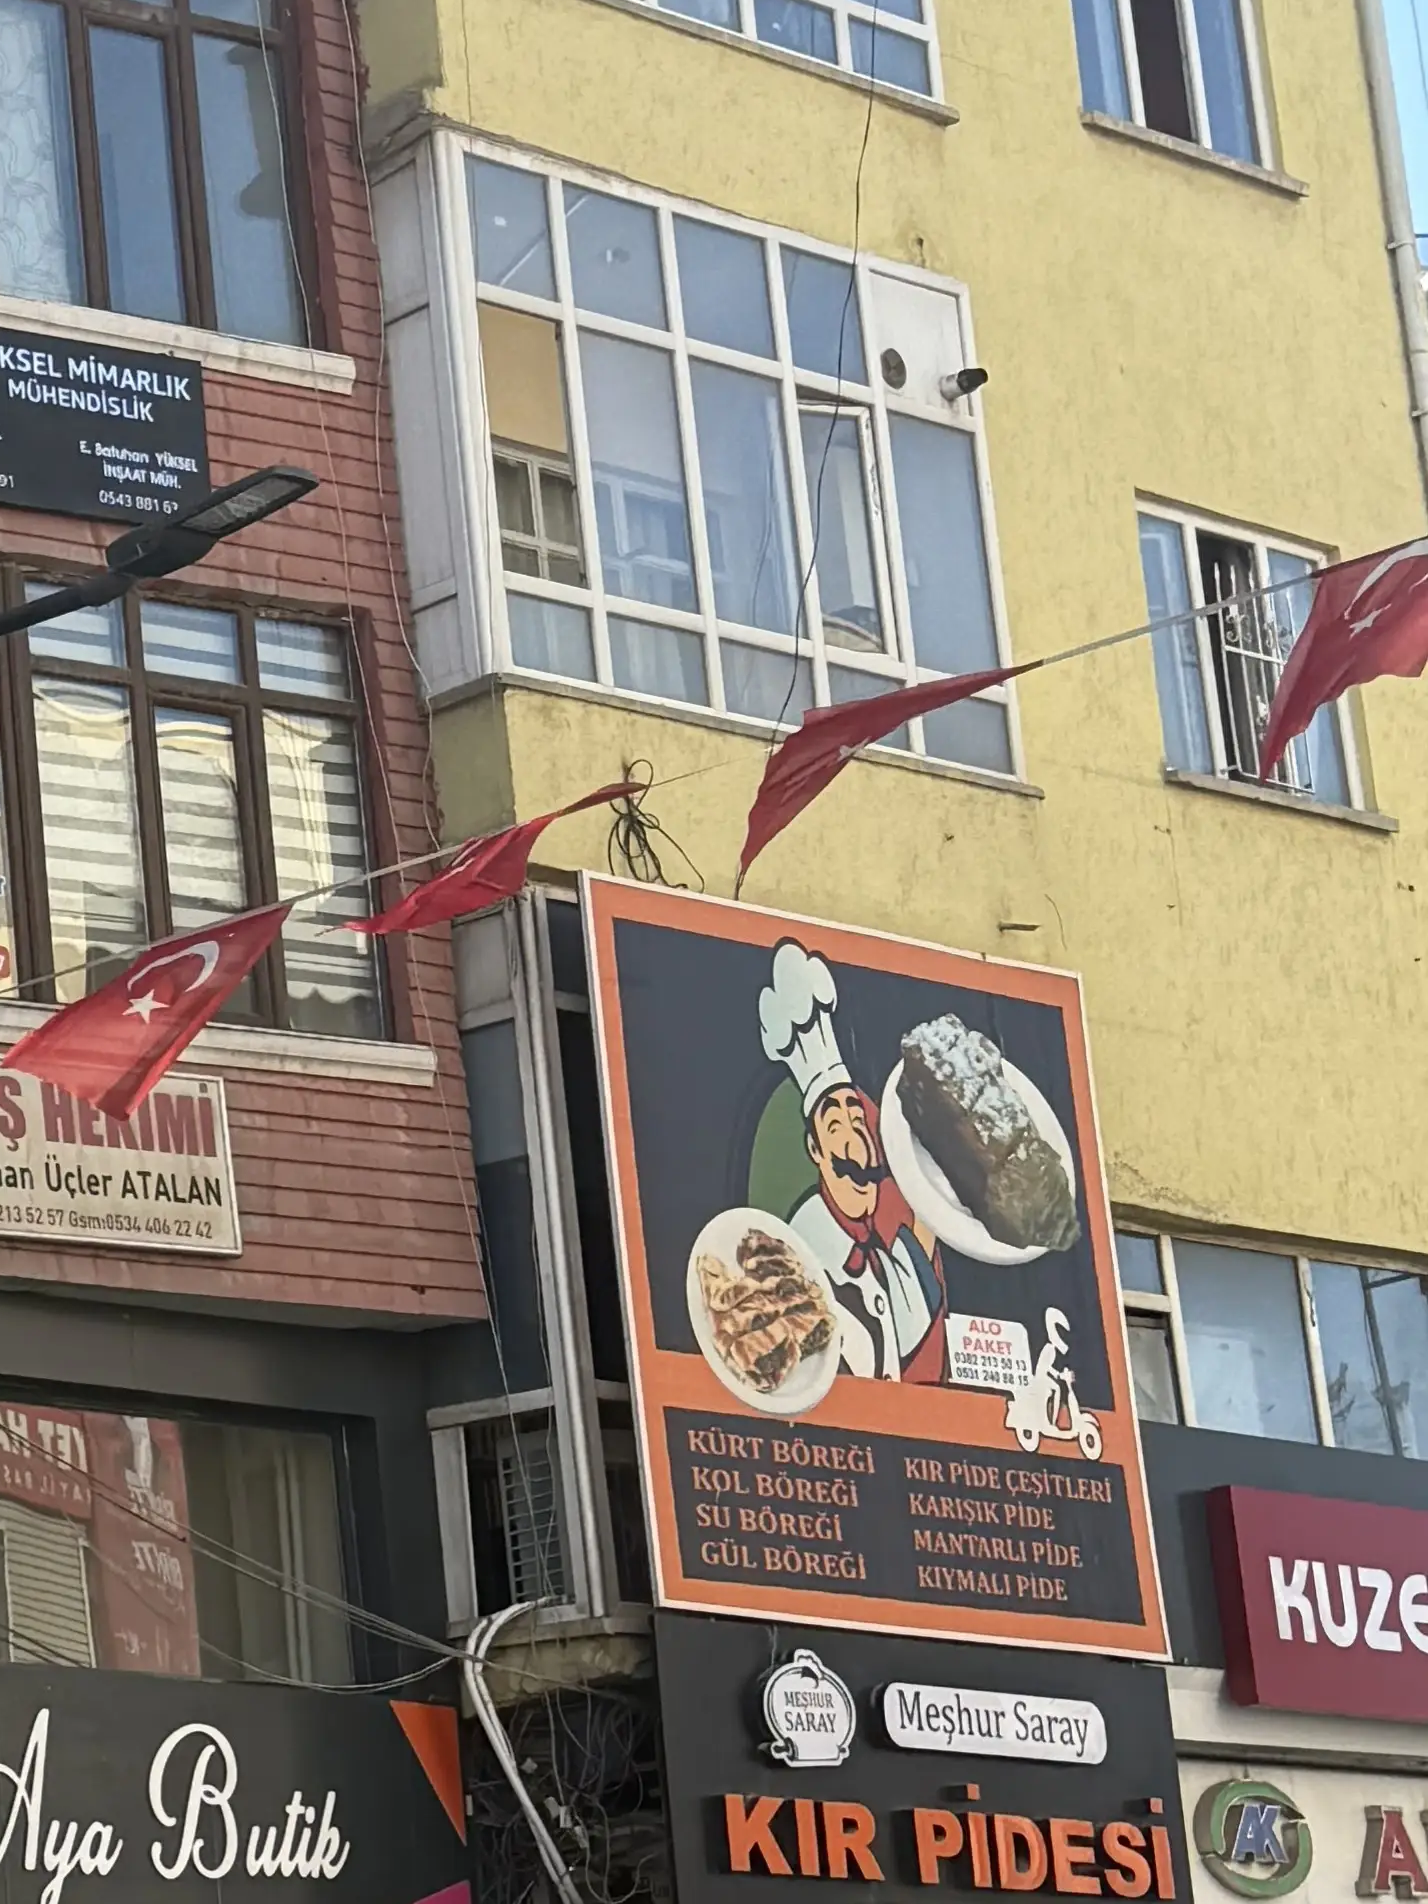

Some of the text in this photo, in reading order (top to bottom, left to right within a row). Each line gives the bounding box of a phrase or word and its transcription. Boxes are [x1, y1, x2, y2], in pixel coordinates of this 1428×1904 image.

[67, 355, 192, 402] MİMARLIK
[8, 377, 154, 424] MÜHENDİSLİK
[155, 452, 199, 473] YÜKSEL
[44, 1154, 112, 1199] Üçler
[121, 1170, 223, 1208] ATALAN
[963, 1336, 1012, 1355] PAKET
[969, 1320, 1001, 1336] ALO
[688, 1426, 876, 1475] KÜRT BÖREĞİ
[692, 1466, 859, 1508] KOL BÖREĞİ
[904, 1457, 1112, 1504] KIR PİDE ÇEŞİTLERİ
[696, 1503, 843, 1542] SU BÖREĞİ
[909, 1493, 1056, 1531] KARIŞIK PİDE
[701, 1538, 867, 1580] GÜL BÖREĞİ
[914, 1529, 1083, 1568] MANTARLI PİDE
[918, 1565, 1068, 1601] KIYMALI PİDE
[784, 1689, 835, 1713] MEŞHUR
[784, 1710, 837, 1735] SARAY
[897, 1689, 1090, 1758] Meşhur Saray
[148, 1722, 351, 1880] Butik
[724, 1783, 1176, 1901] KIR PİDESİ
